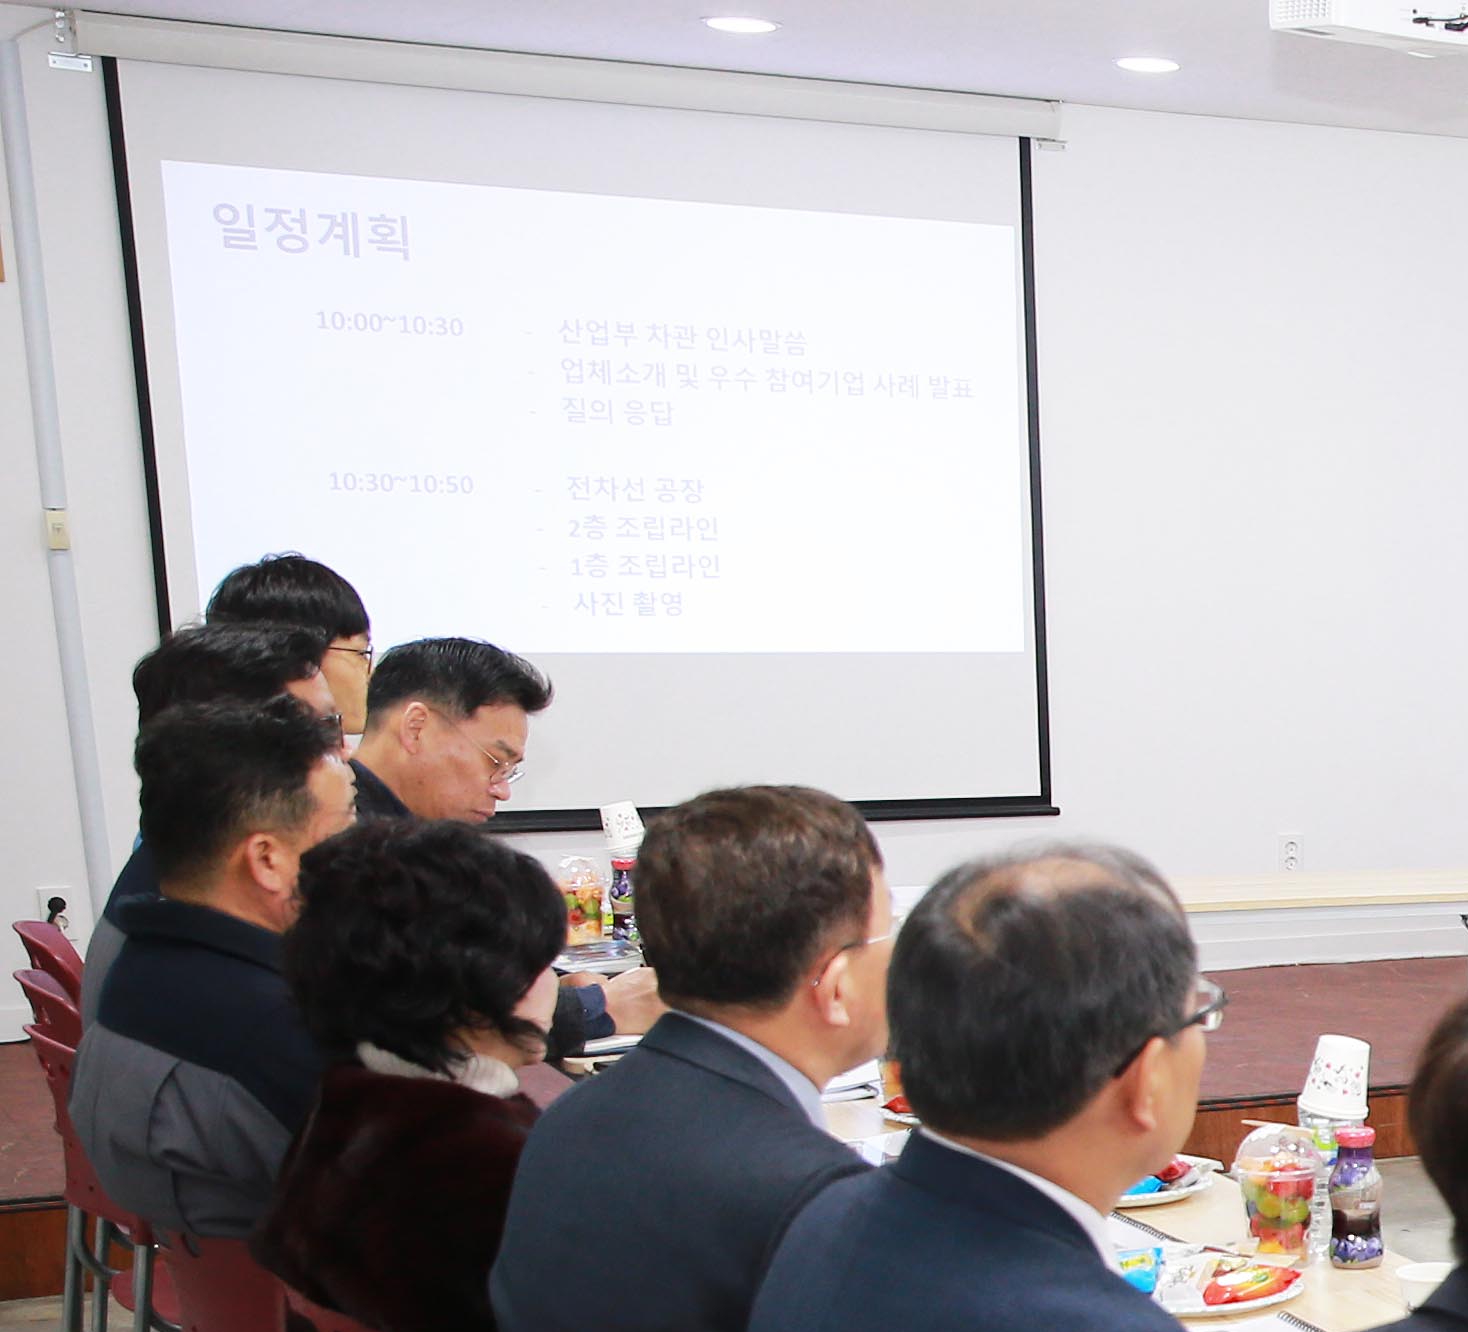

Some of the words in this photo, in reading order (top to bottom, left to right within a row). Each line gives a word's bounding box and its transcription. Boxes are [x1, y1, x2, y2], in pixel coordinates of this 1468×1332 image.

[213, 203, 410, 262] 일정계획
[316, 310, 463, 336] 10:00~10:30
[558, 319, 637, 347] 산업부
[646, 323, 698, 349] 차관
[707, 328, 807, 356] 인사말씀
[561, 358, 666, 388] 업체소개
[676, 364, 699, 390] 및
[709, 366, 757, 392] 우수
[766, 368, 864, 396] 참여기업
[874, 374, 918, 400] 사례
[929, 376, 971, 400] 발표
[562, 397, 613, 424] 질의
[624, 400, 674, 426] 응답
[330, 472, 473, 494] 10:30~10:50
[567, 476, 644, 502] 전차선
[655, 478, 704, 504] 공장
[569, 514, 607, 539] 2층
[616, 516, 717, 542] 조립라인
[572, 553, 608, 578] 1층
[618, 554, 720, 579] 조립라인
[574, 592, 624, 616] 사진
[633, 592, 682, 616] 촬영
